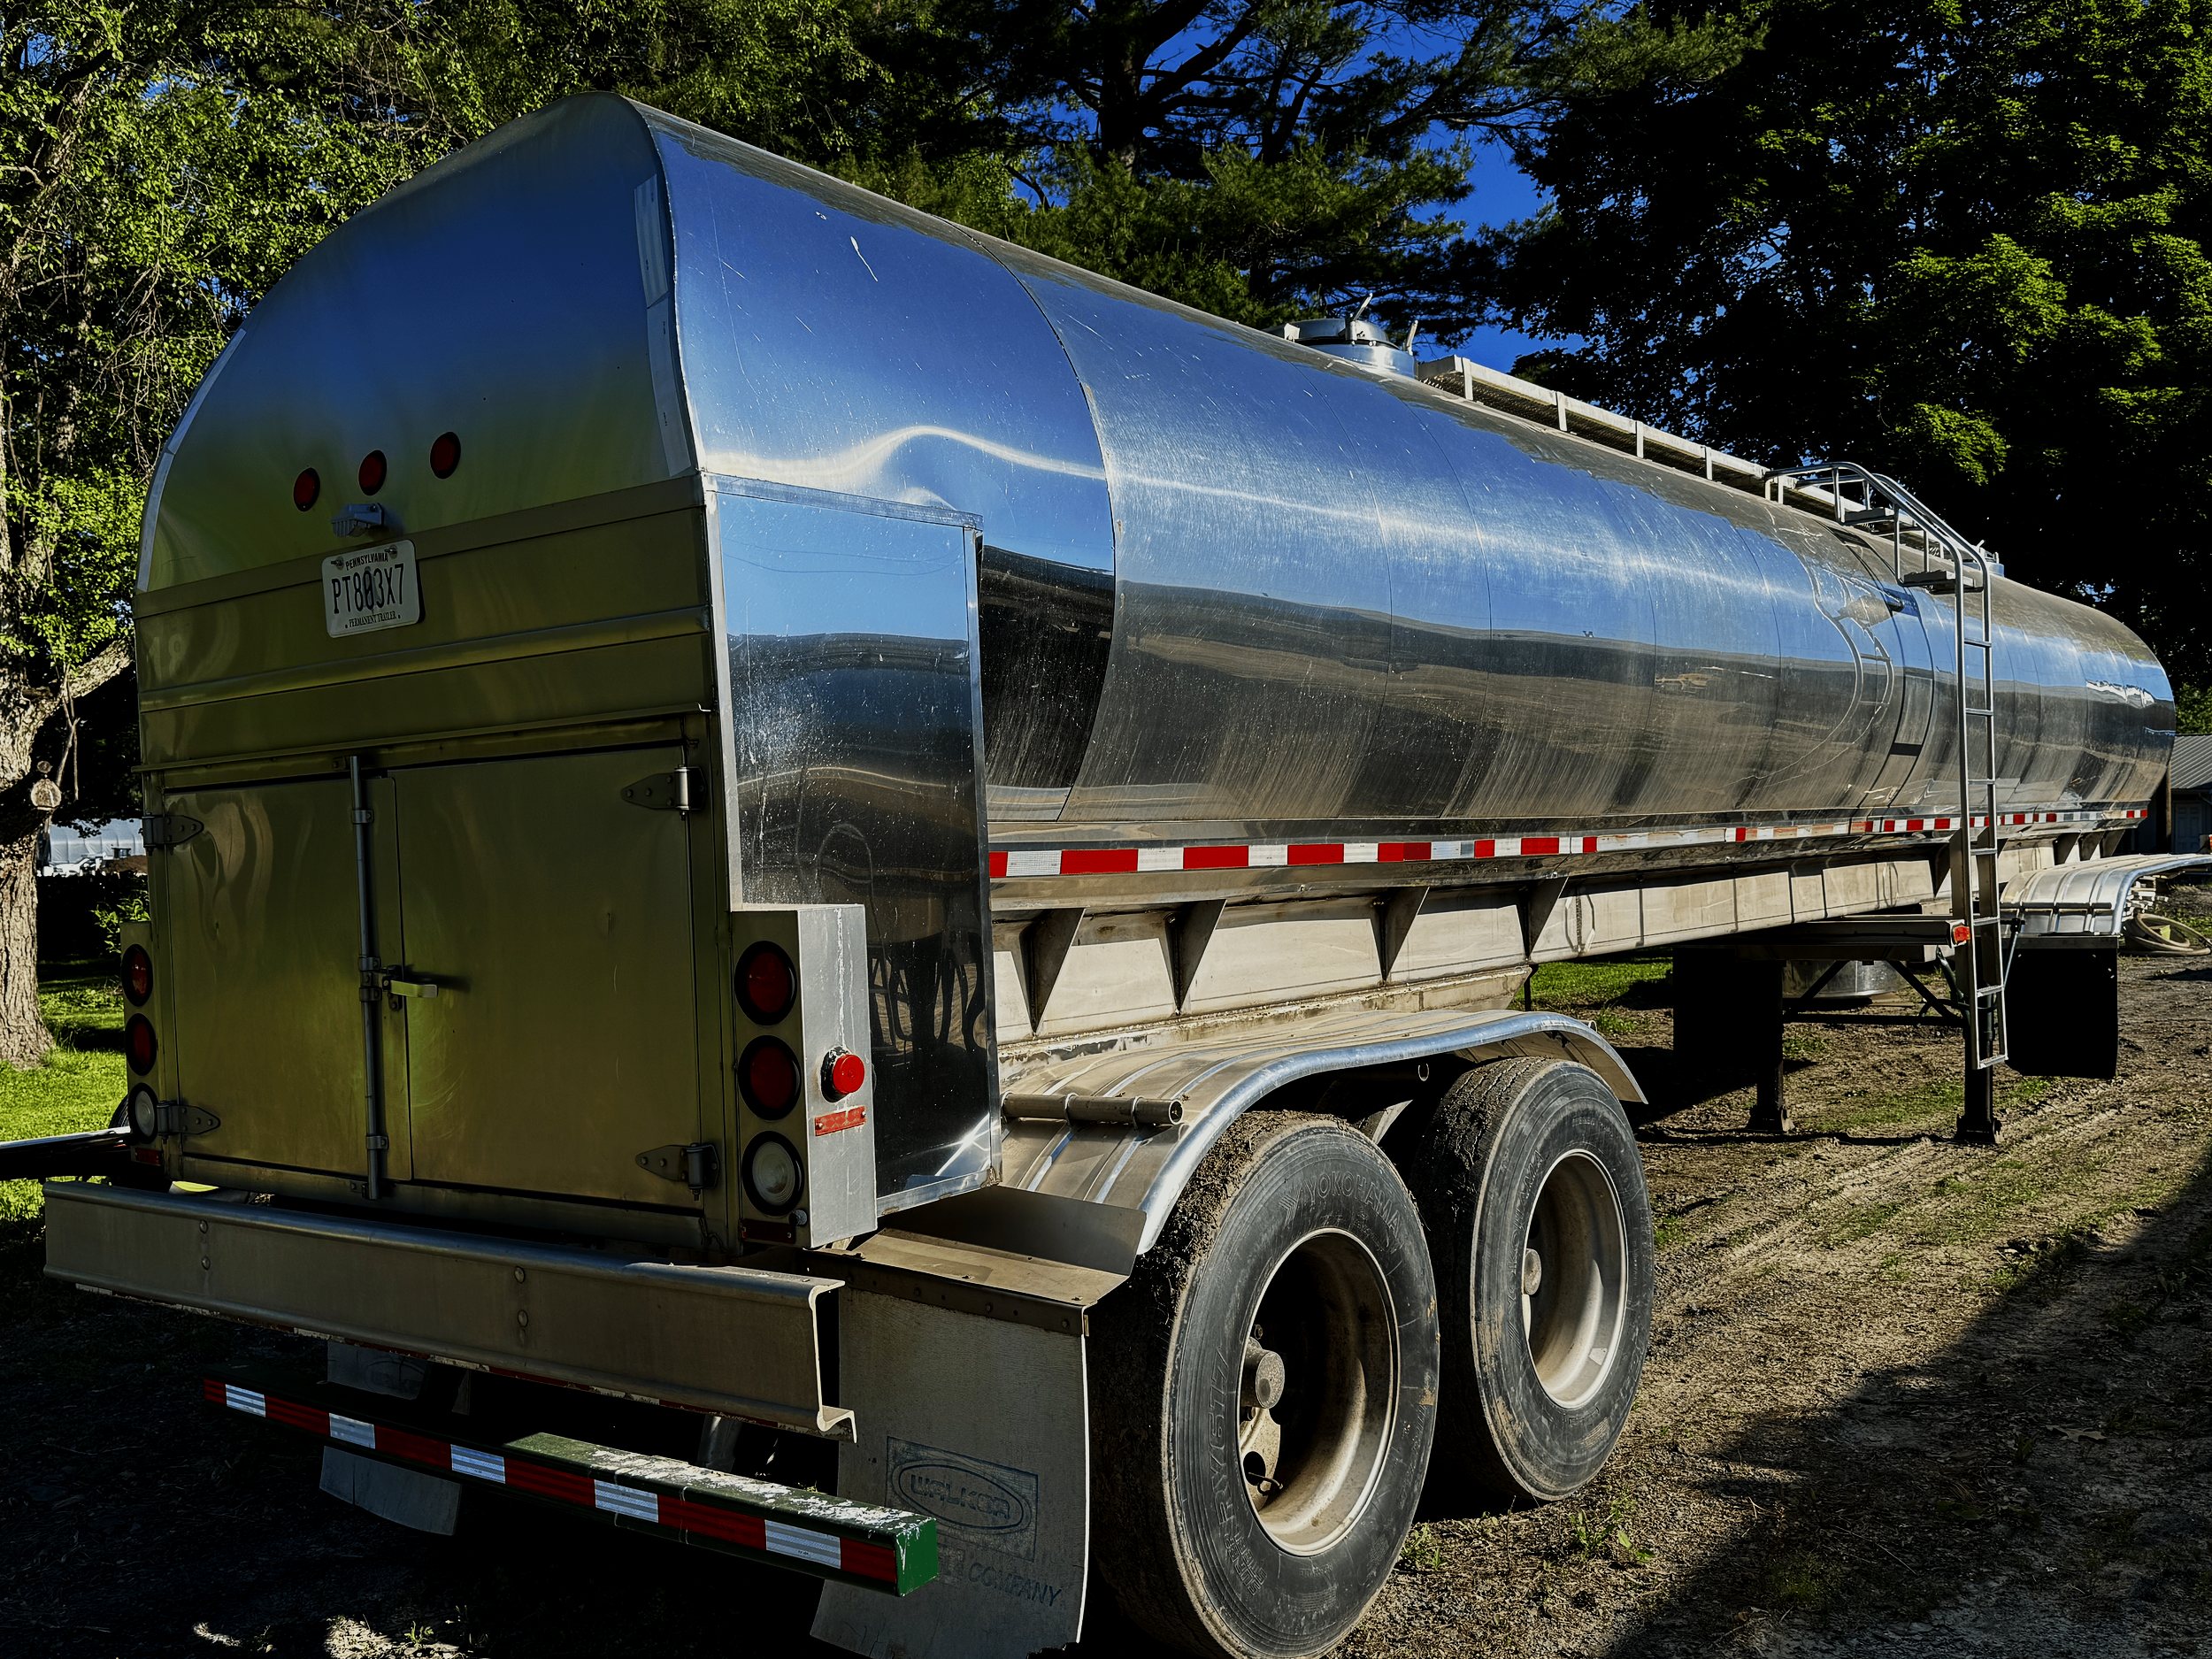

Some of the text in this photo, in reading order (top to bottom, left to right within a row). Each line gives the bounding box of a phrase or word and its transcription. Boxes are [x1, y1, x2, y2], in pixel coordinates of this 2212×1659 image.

[345, 552, 388, 571] PENNSYLVANIA
[331, 563, 404, 614] PT803X7
[349, 611, 397, 628] PERMANENT TRAILER
[1304, 1170, 1401, 1239] YOKOHAMA
[1208, 1348, 1234, 1525] RY617
[969, 1562, 1063, 1607] COMPANY
[1224, 1533, 1261, 1596] SUPER
